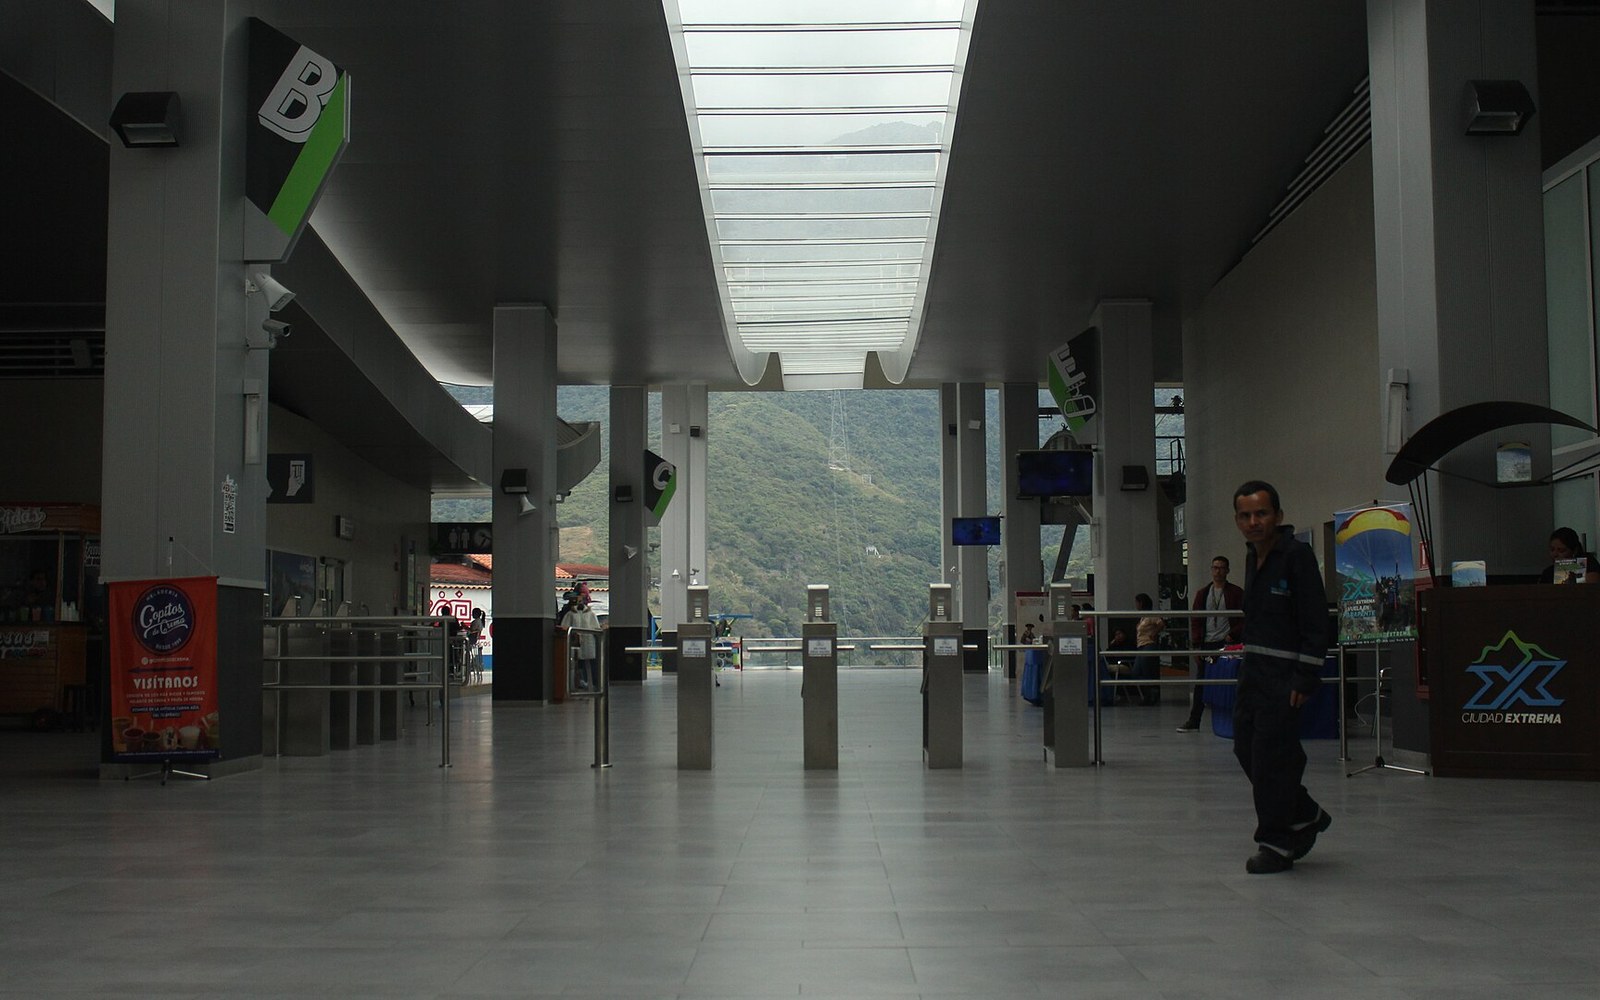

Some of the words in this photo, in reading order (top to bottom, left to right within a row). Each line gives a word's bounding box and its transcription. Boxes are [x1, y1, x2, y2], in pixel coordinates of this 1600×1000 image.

[257, 45, 338, 144] B
[653, 461, 674, 491] C
[140, 602, 185, 629] Copitos
[160, 618, 186, 635] Crema
[133, 675, 199, 690] VISÍTANOS
[1461, 712, 1504, 724] CIUDAD
[1504, 713, 1562, 725] EXTREMA
